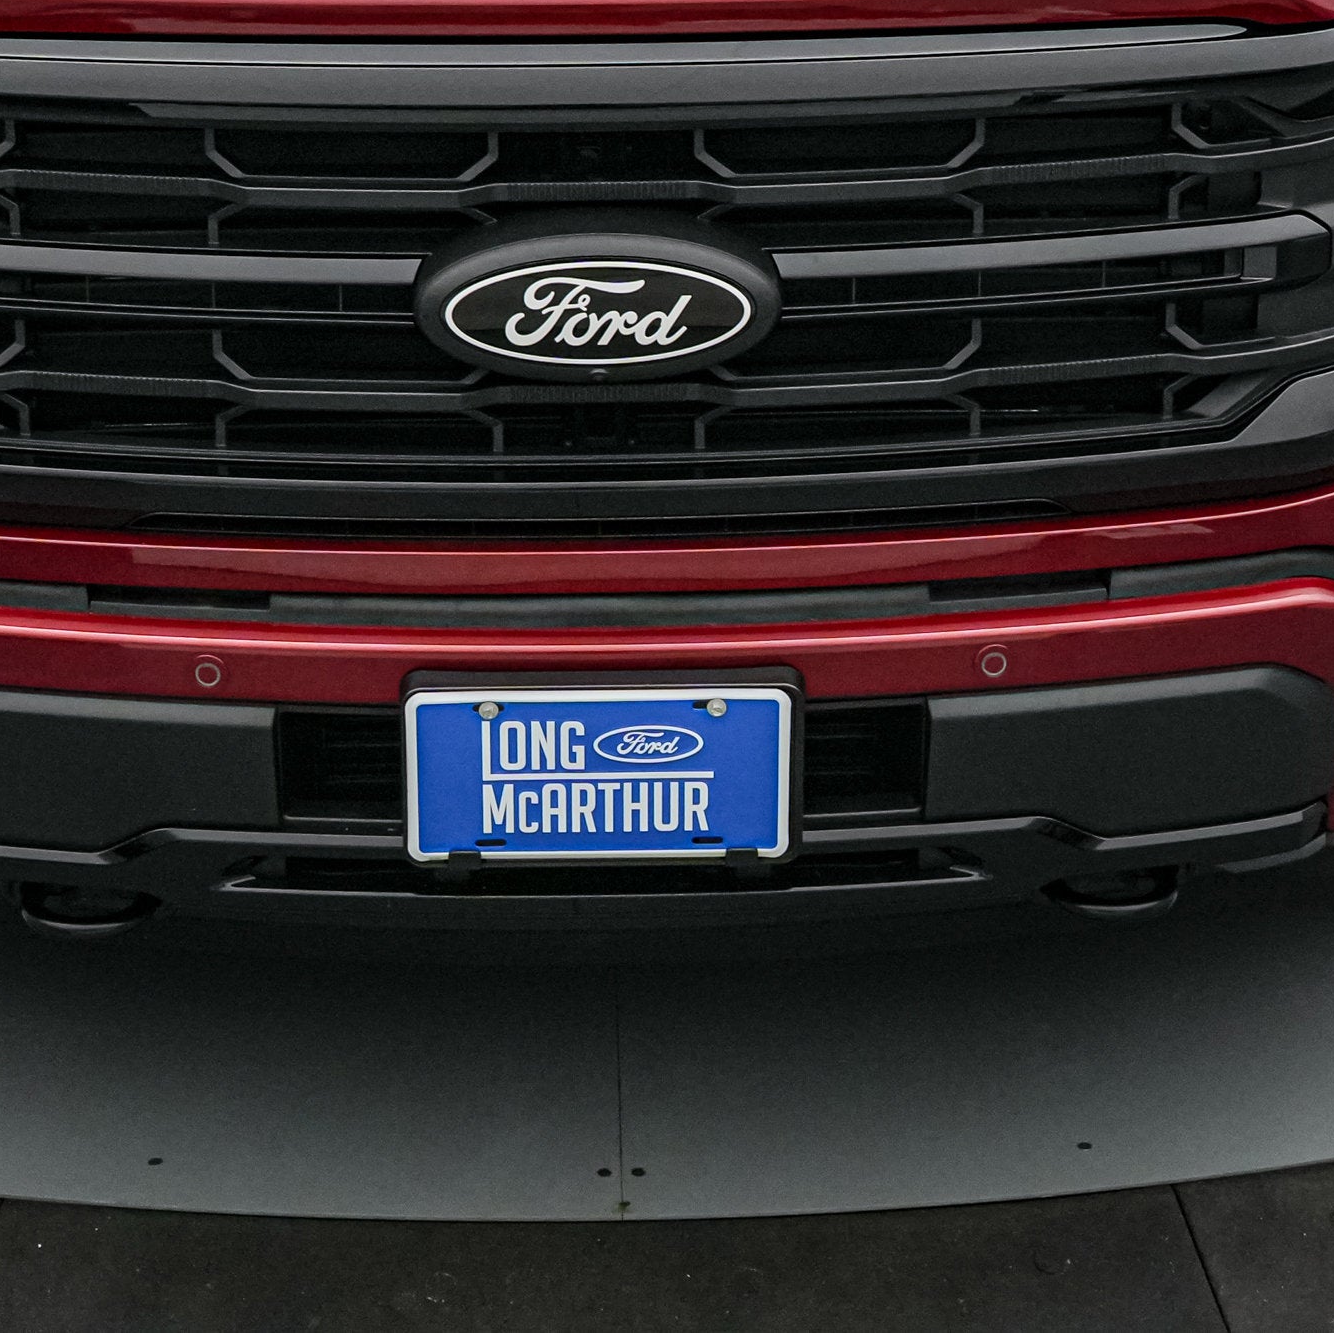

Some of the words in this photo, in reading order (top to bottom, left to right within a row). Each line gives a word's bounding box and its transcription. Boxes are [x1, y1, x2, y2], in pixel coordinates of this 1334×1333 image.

[505, 276, 693, 347] Ford
[482, 720, 586, 776] LONG
[616, 730, 680, 756] Ford
[482, 781, 710, 834] McARTHUR
